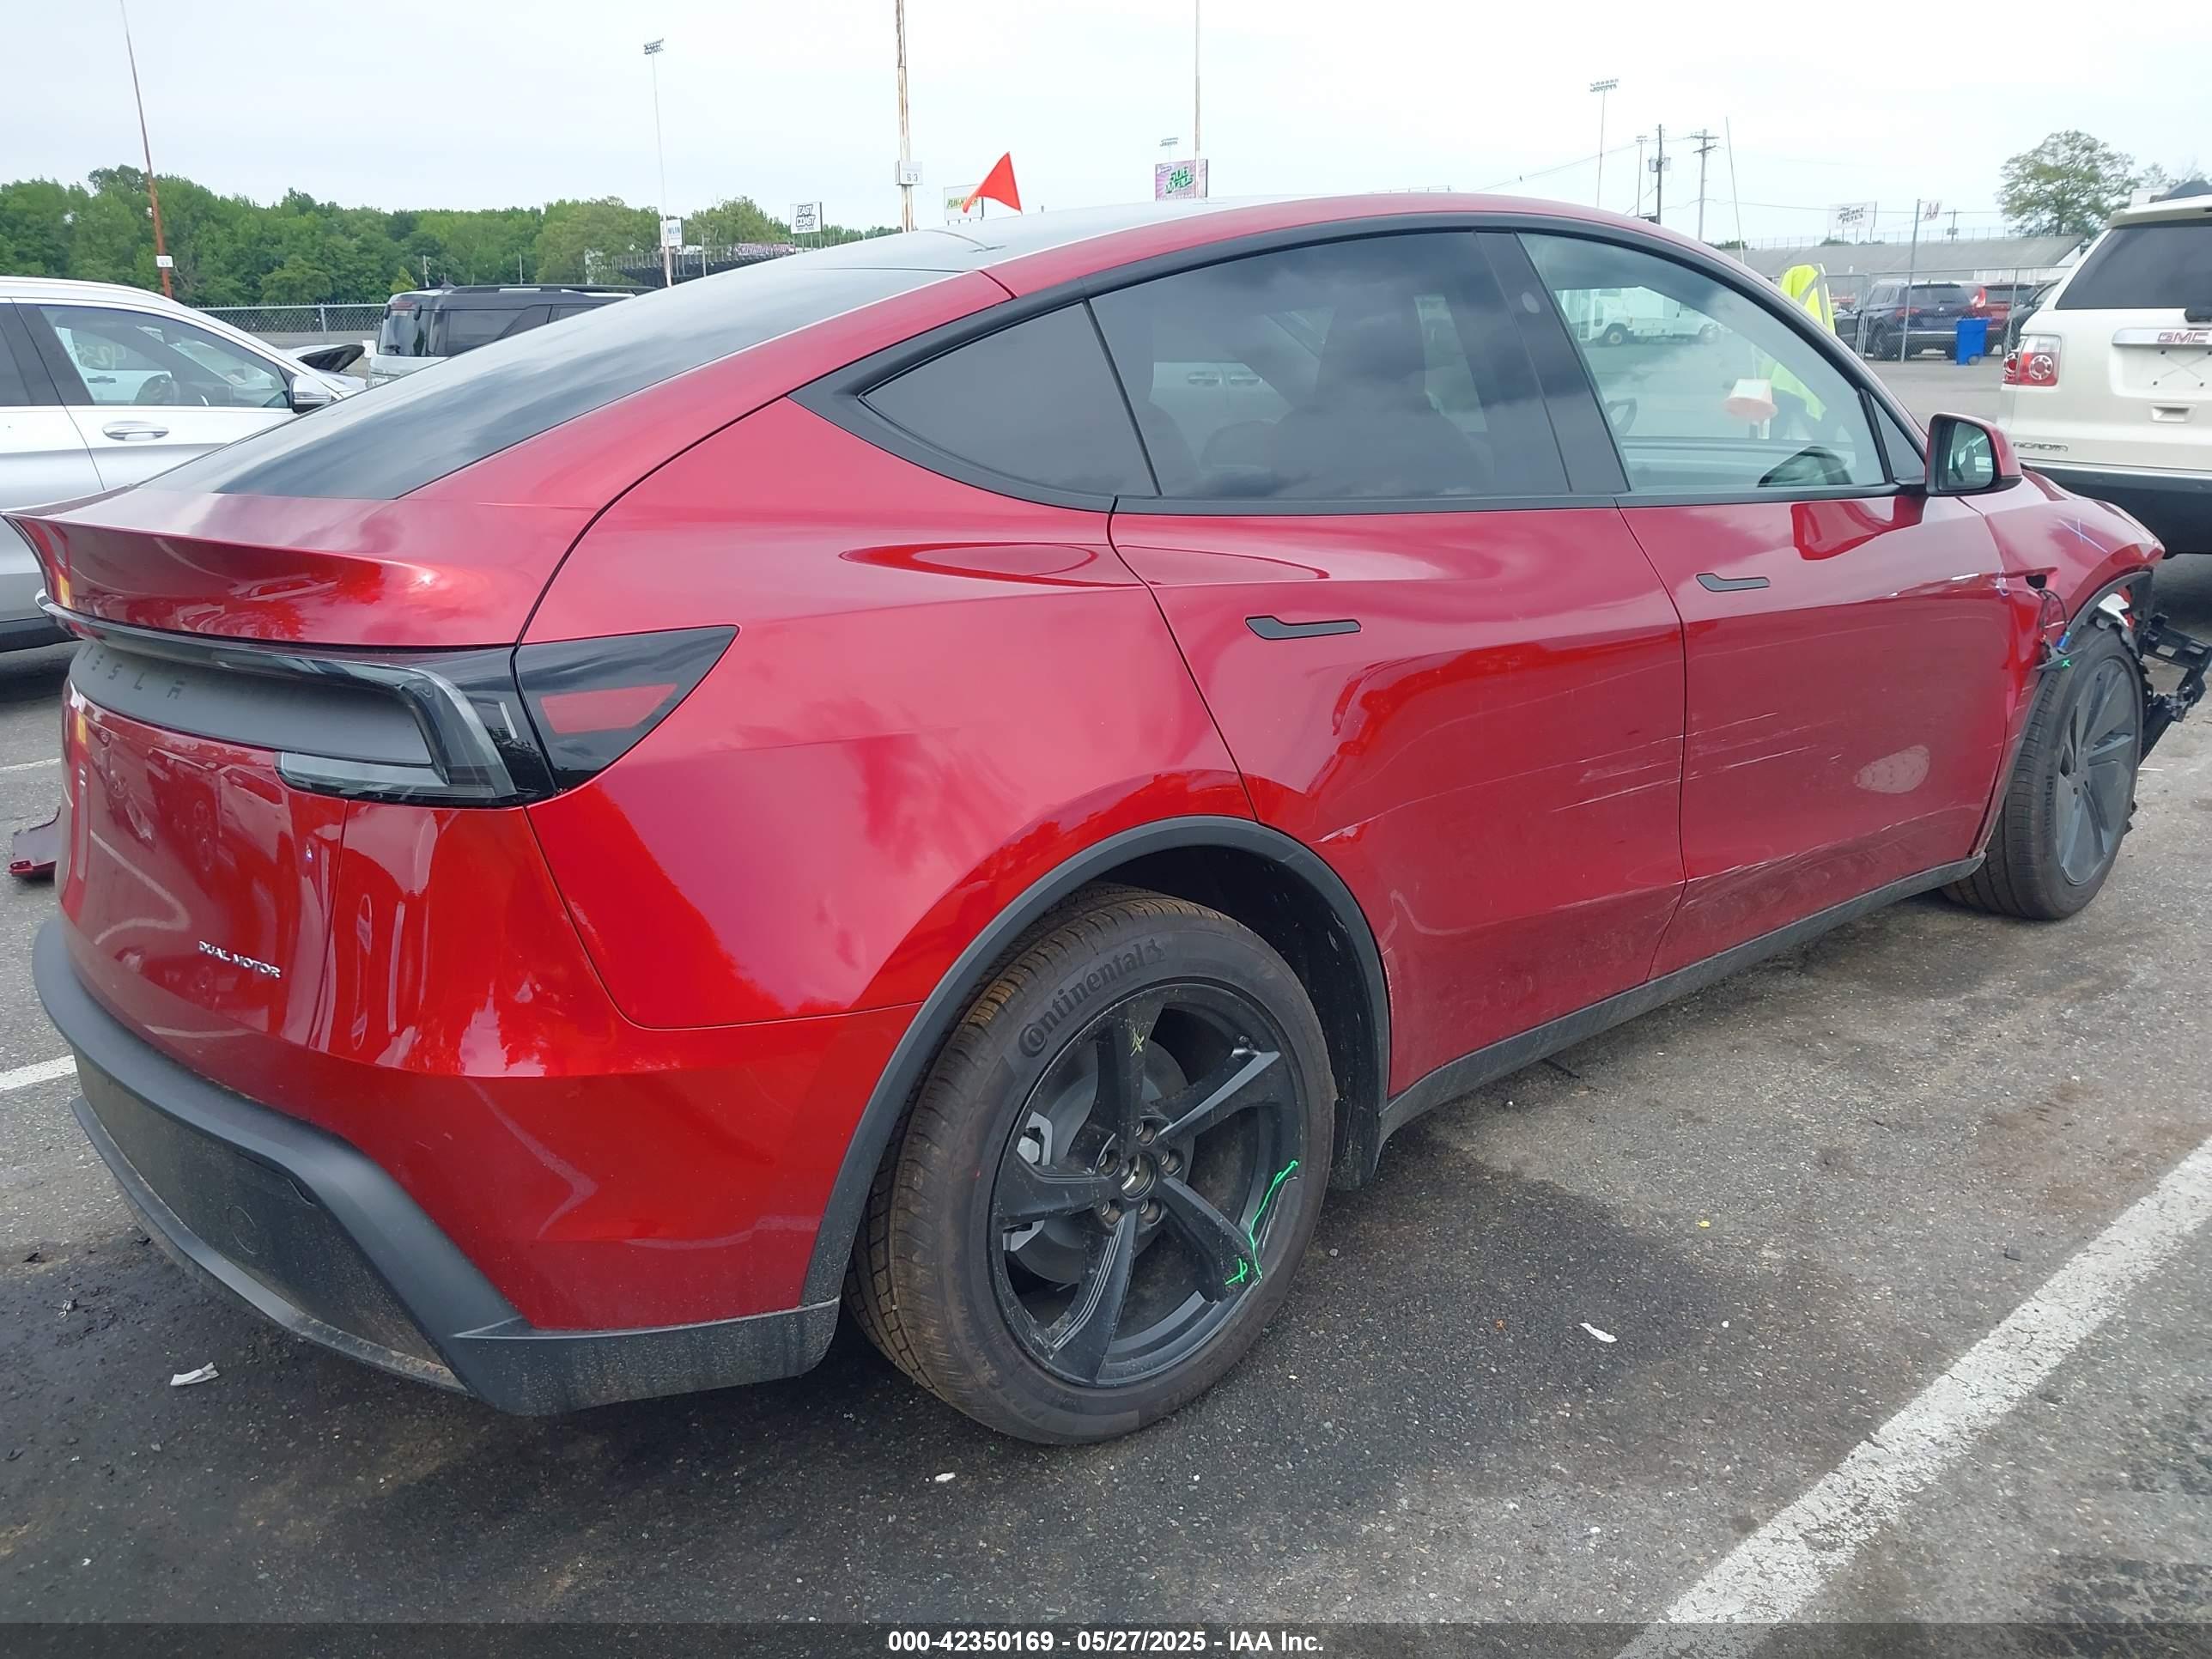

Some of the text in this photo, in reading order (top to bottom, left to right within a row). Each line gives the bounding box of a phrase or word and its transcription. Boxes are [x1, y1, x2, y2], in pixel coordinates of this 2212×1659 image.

[797, 204, 814, 216] EAST
[796, 215, 817, 227] COAST
[2157, 331, 2209, 343] GMC
[198, 940, 281, 979] DUAL MOTOR
[1018, 943, 1146, 1057] Continental
